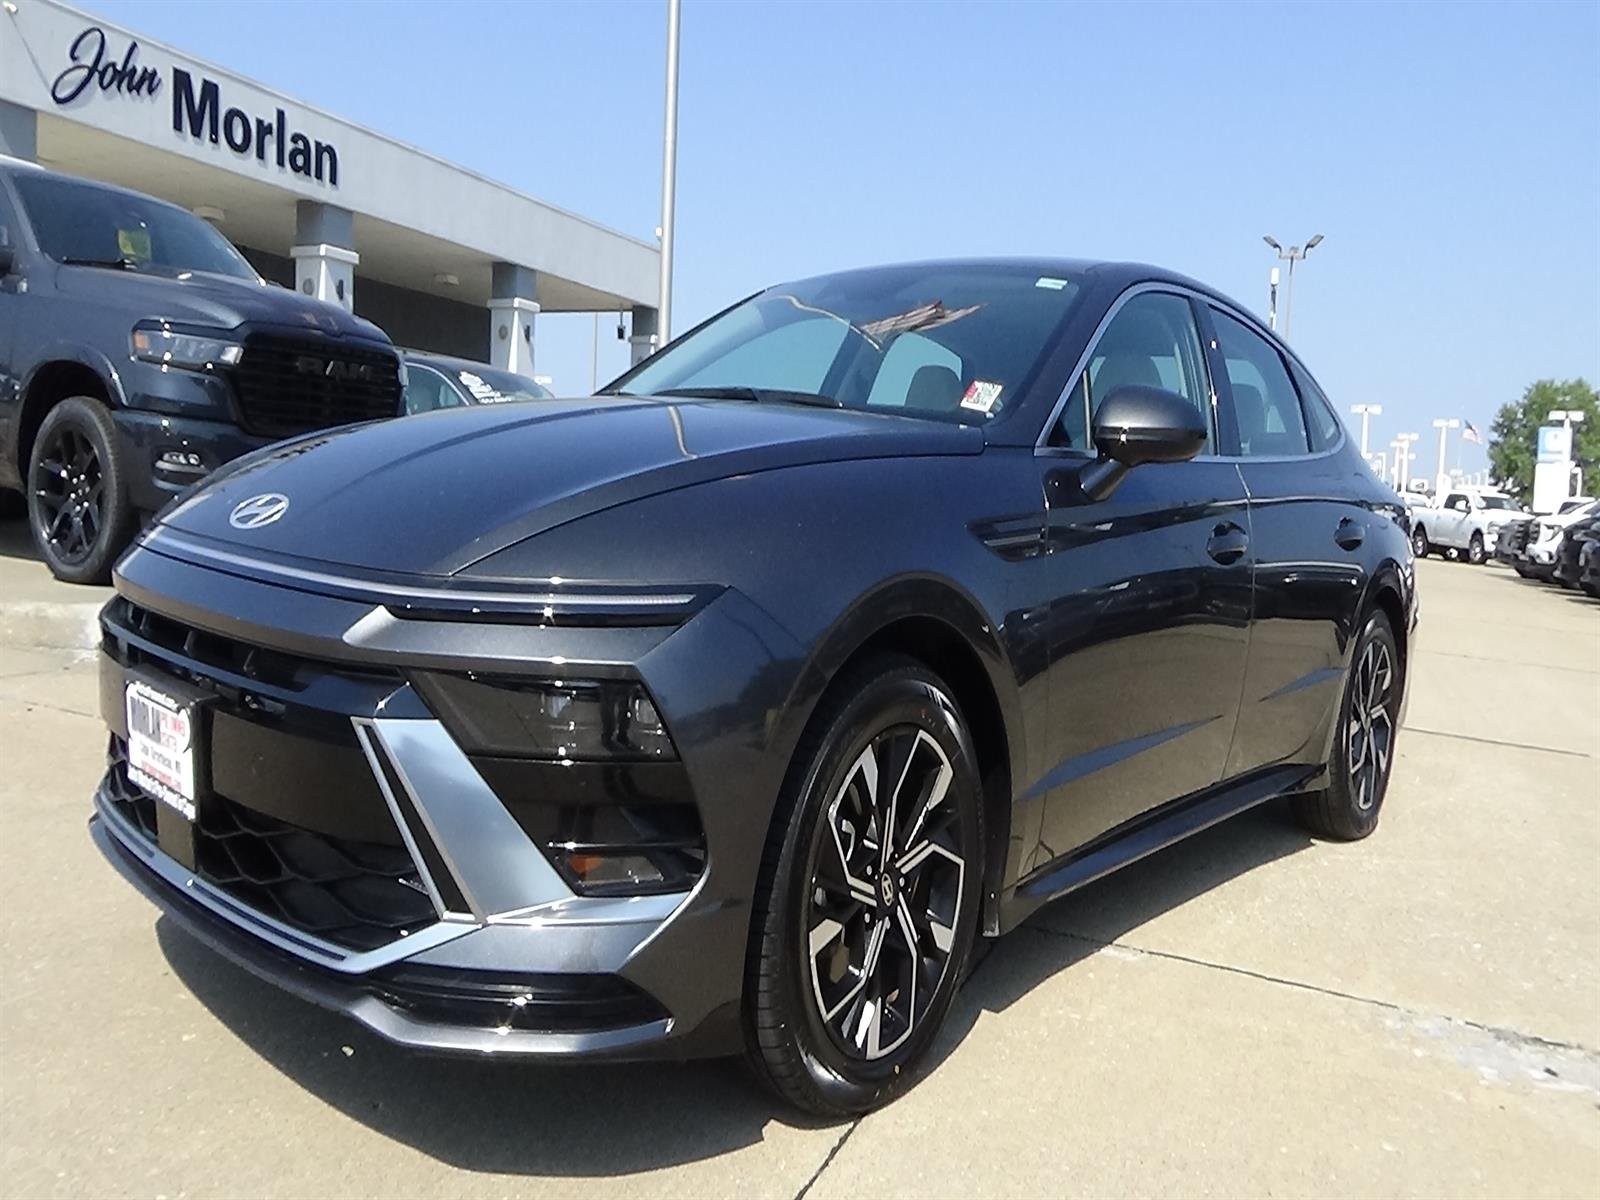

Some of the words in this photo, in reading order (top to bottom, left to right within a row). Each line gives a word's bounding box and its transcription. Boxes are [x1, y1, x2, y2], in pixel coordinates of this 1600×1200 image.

[52, 27, 161, 104] John
[172, 67, 338, 186] Morlan
[296, 357, 374, 380] RAM
